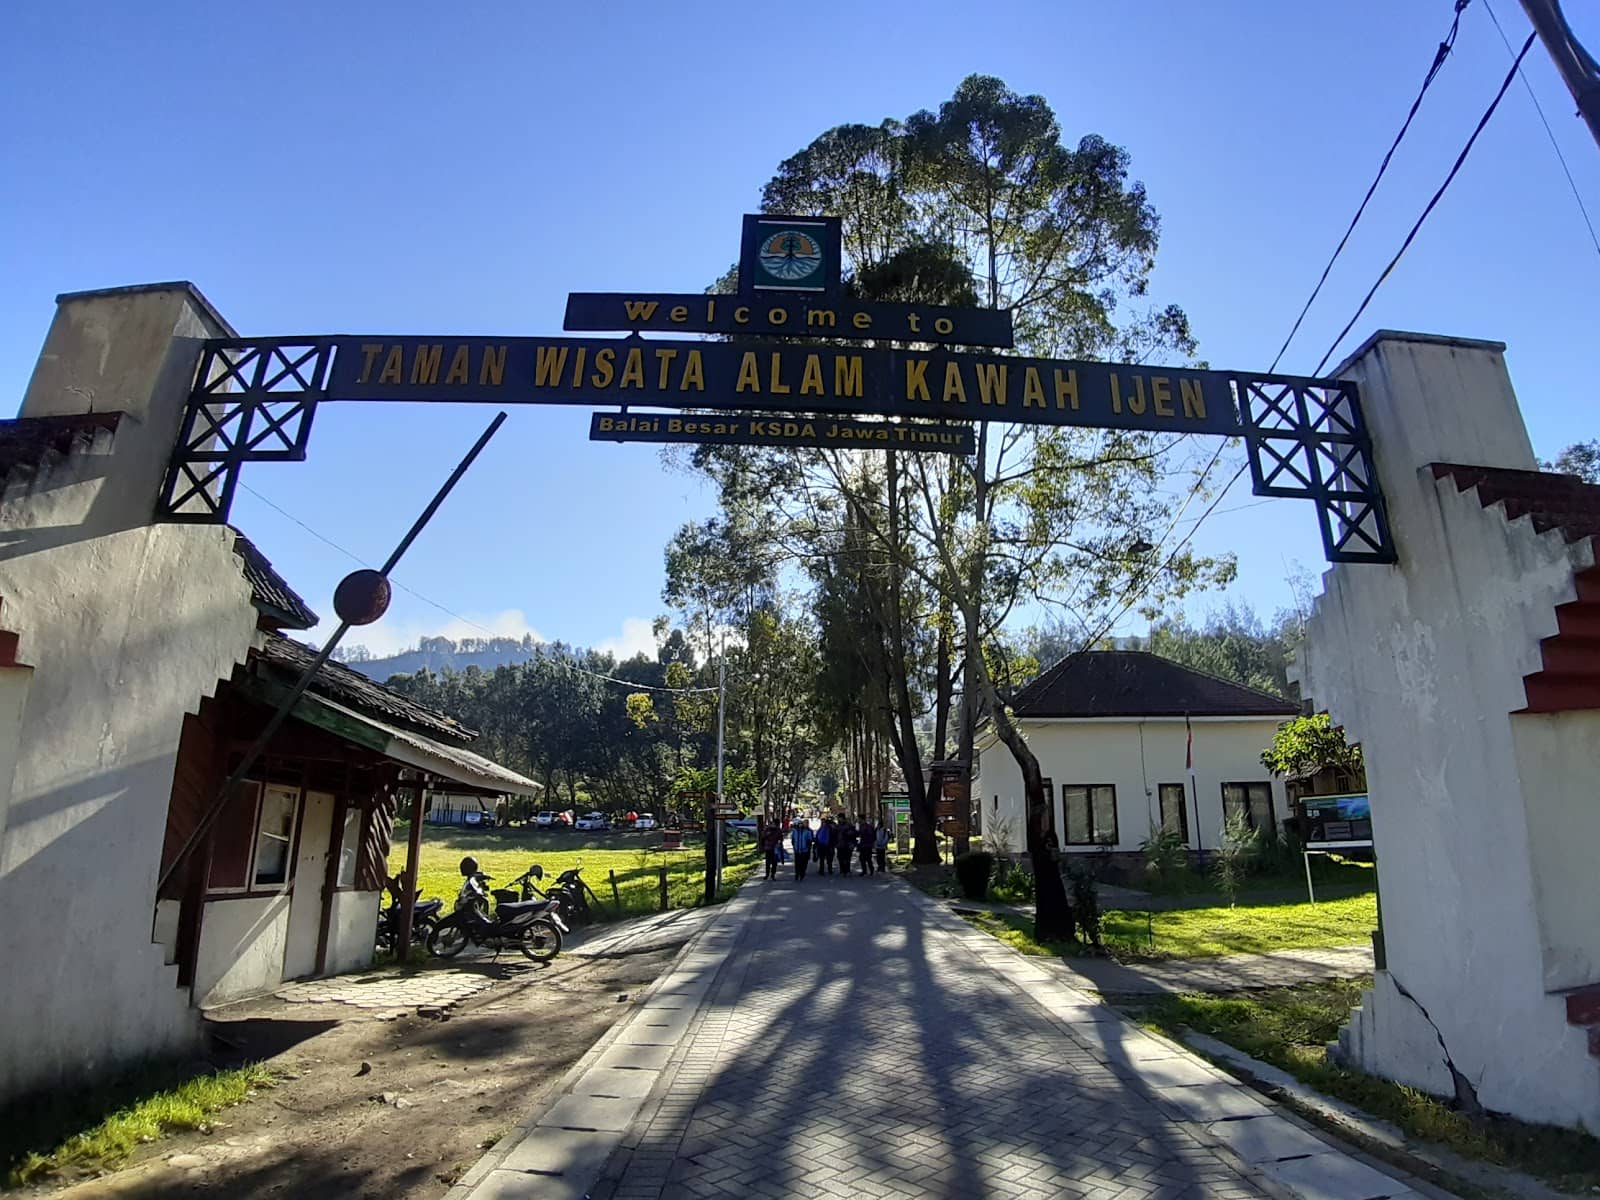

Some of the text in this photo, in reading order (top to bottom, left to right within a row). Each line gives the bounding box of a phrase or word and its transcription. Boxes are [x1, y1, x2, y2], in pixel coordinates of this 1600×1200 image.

[907, 312, 953, 335] to
[357, 344, 1207, 419] TAMAN WISATA ALAM KAWAH IJEN
[599, 417, 964, 444] Balai Besar KSDA Jawa Timur
